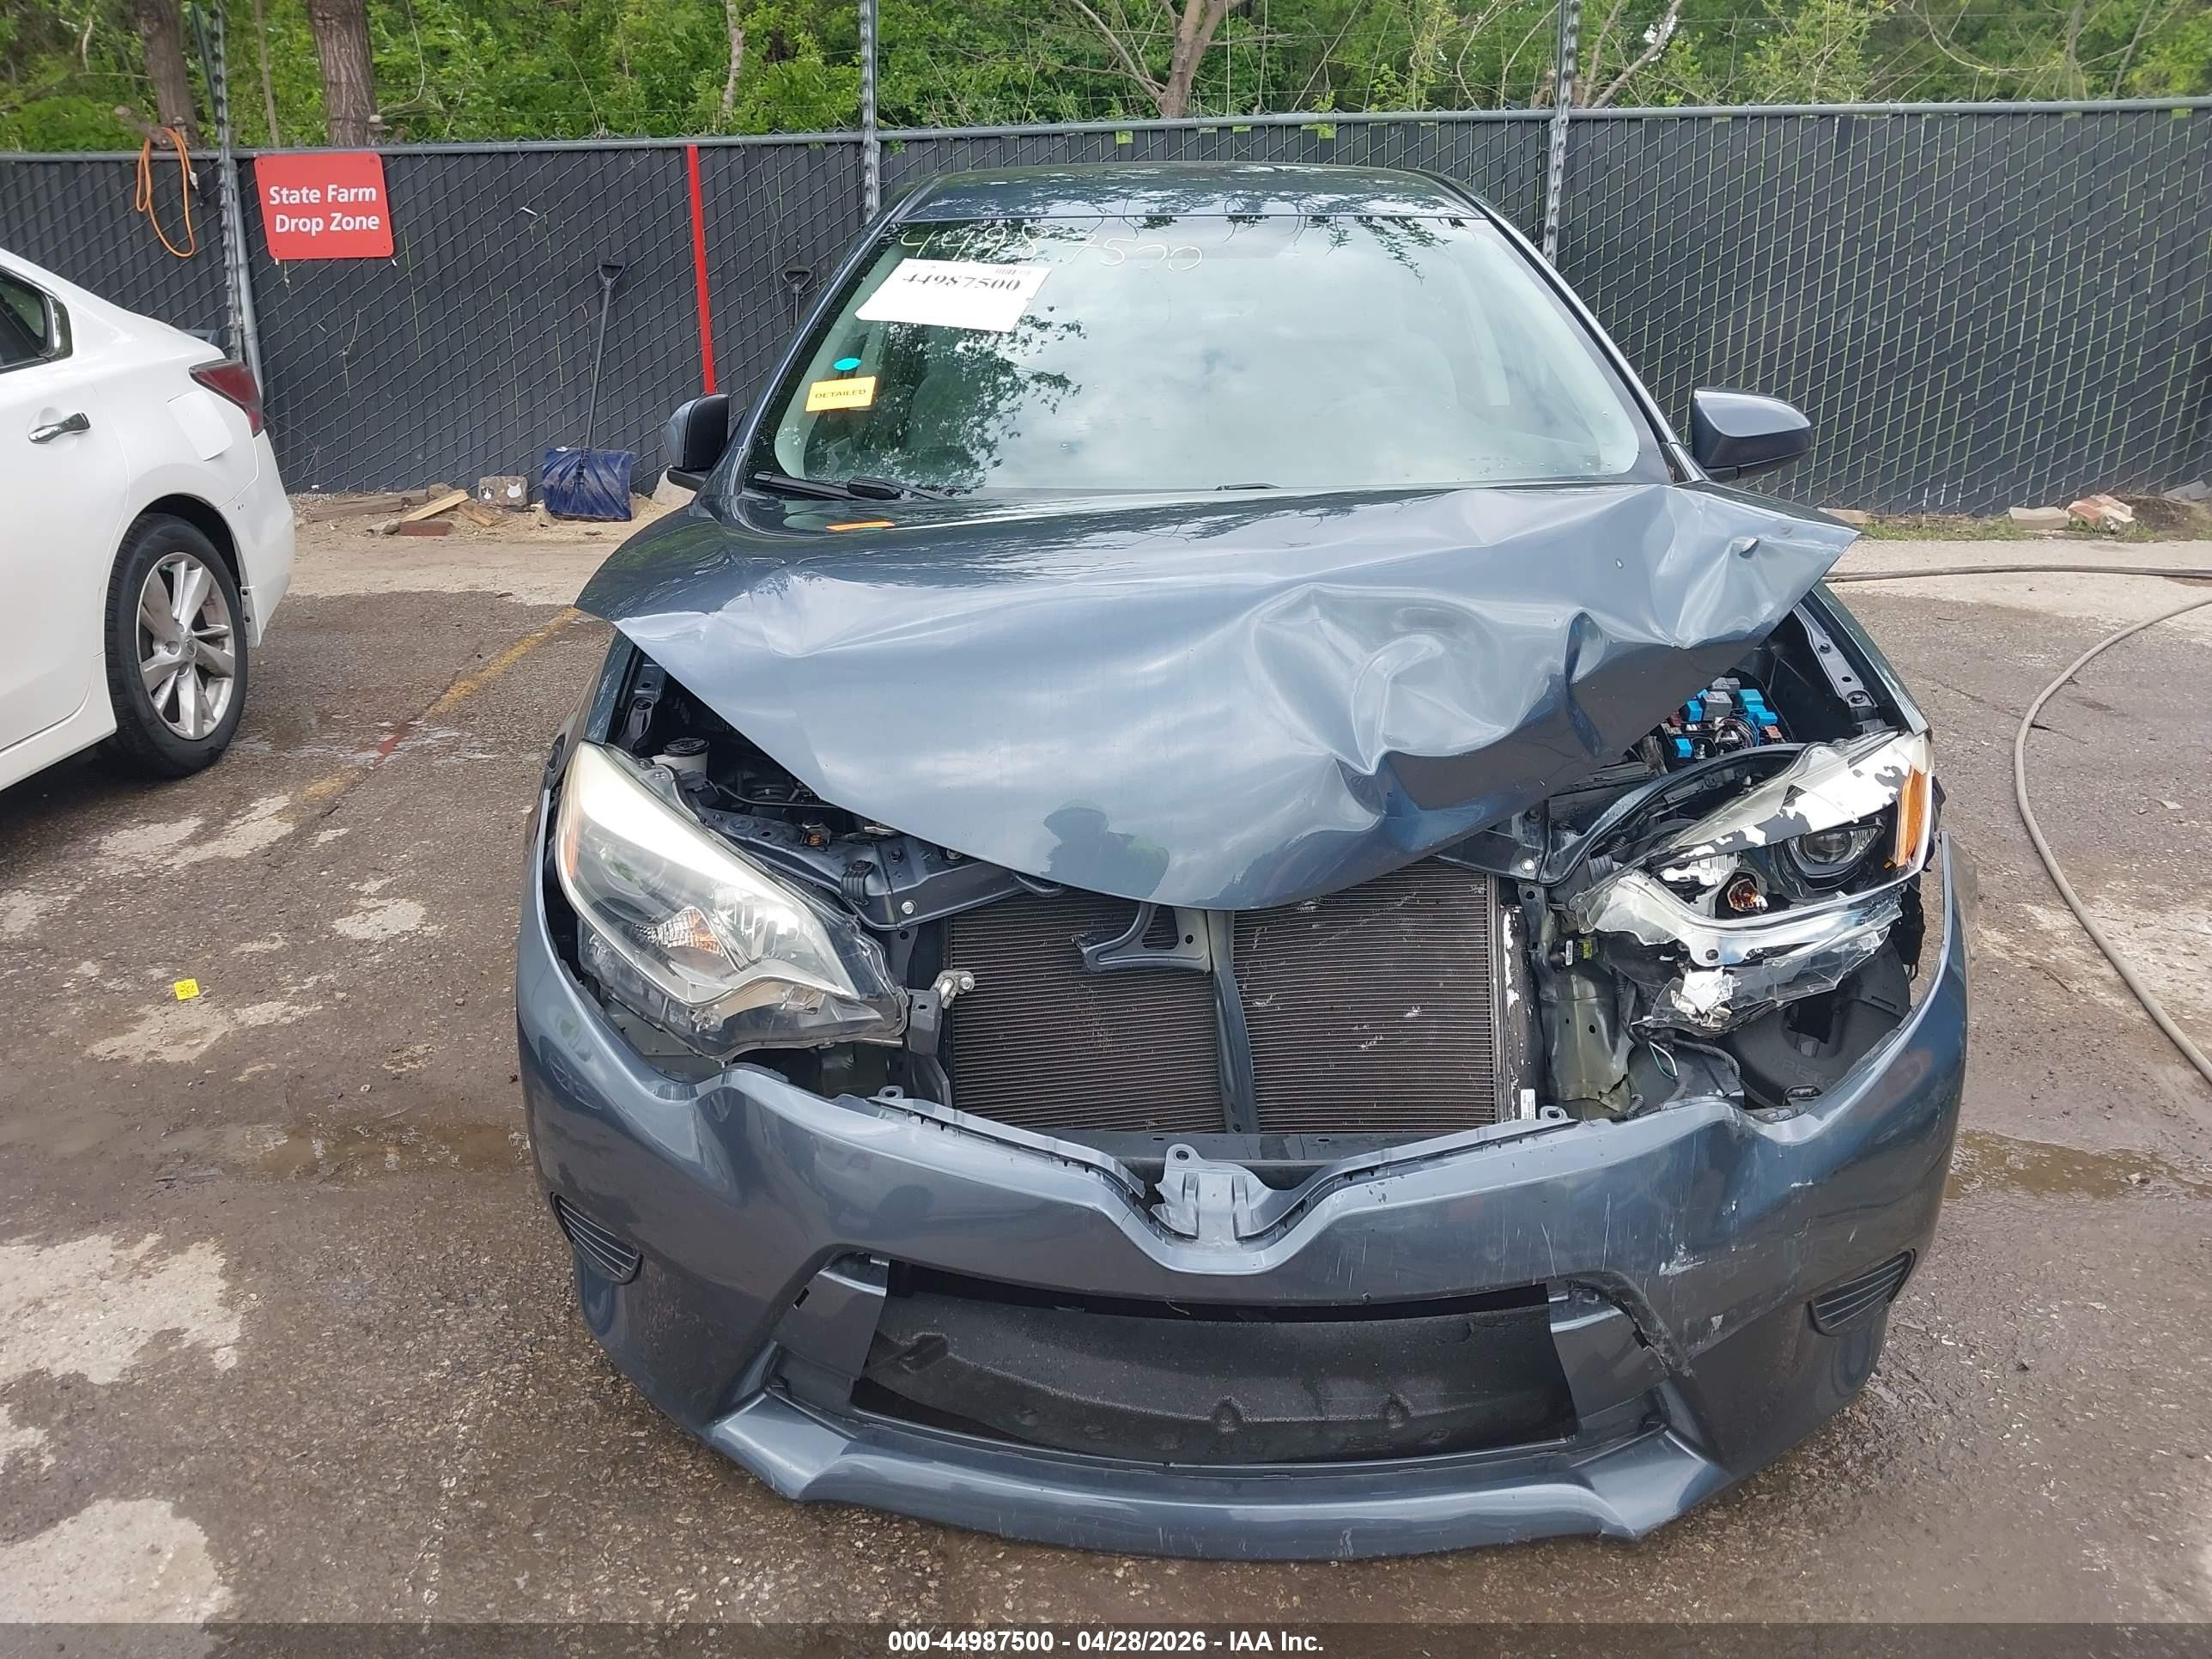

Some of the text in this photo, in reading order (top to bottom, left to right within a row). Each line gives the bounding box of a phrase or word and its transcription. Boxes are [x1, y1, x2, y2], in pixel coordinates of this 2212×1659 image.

[269, 184, 376, 204] State Farm
[275, 212, 380, 236] Drop Zone
[902, 273, 1021, 291] 44987500
[814, 389, 866, 398] DETAILED
